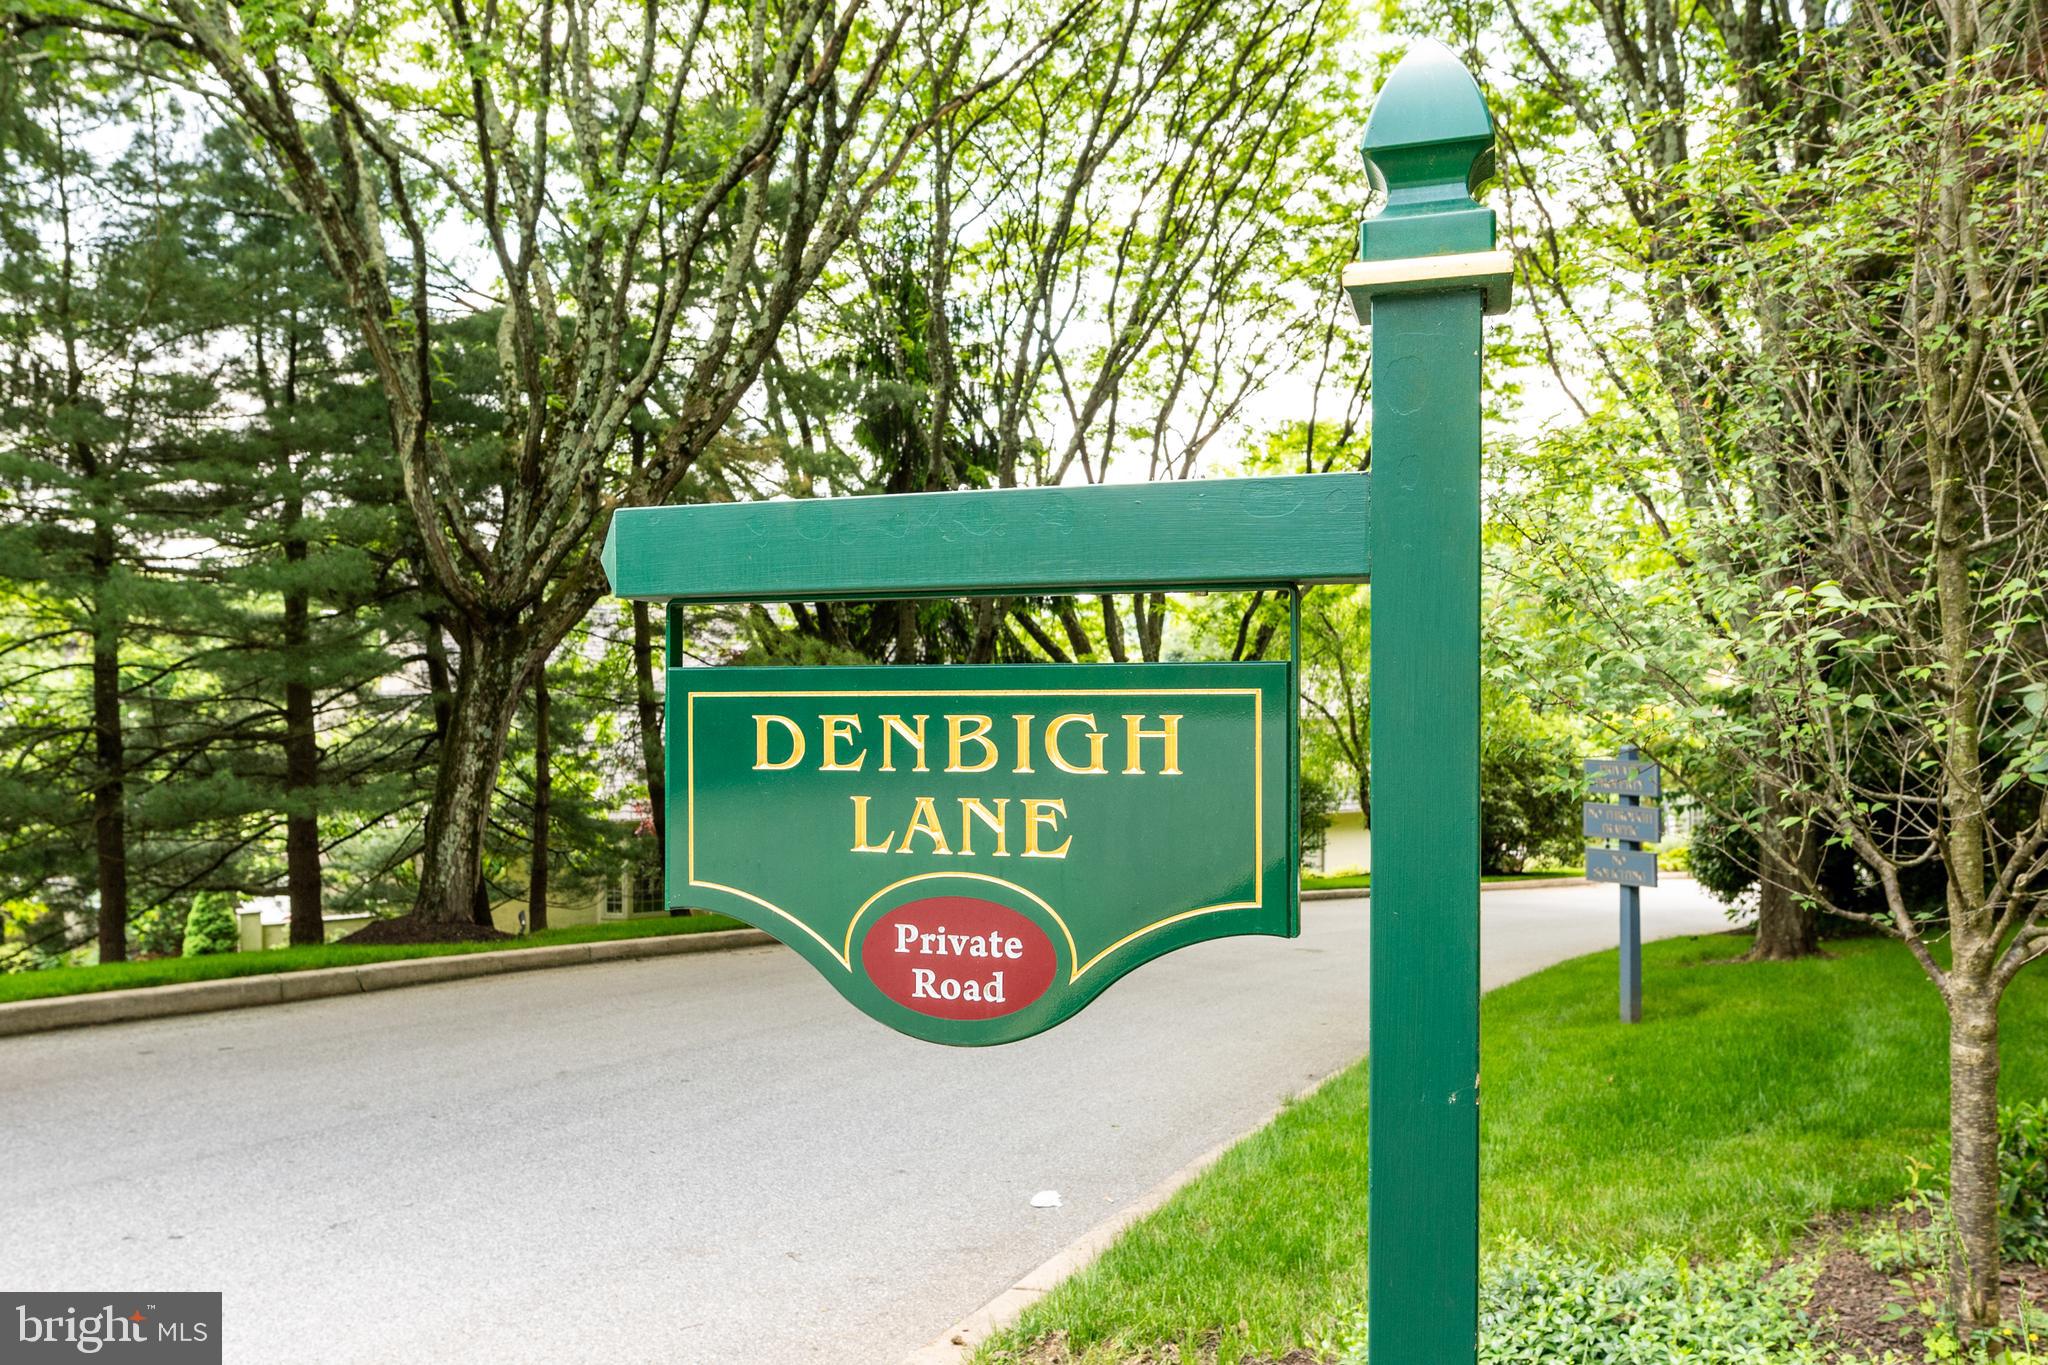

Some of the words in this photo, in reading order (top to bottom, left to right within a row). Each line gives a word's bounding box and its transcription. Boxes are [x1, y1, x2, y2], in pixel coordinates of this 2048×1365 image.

[752, 713, 1183, 775] DENBIGH
[850, 796, 1072, 859] LANE
[893, 923, 1024, 961] Private
[911, 967, 1006, 1004] Road
